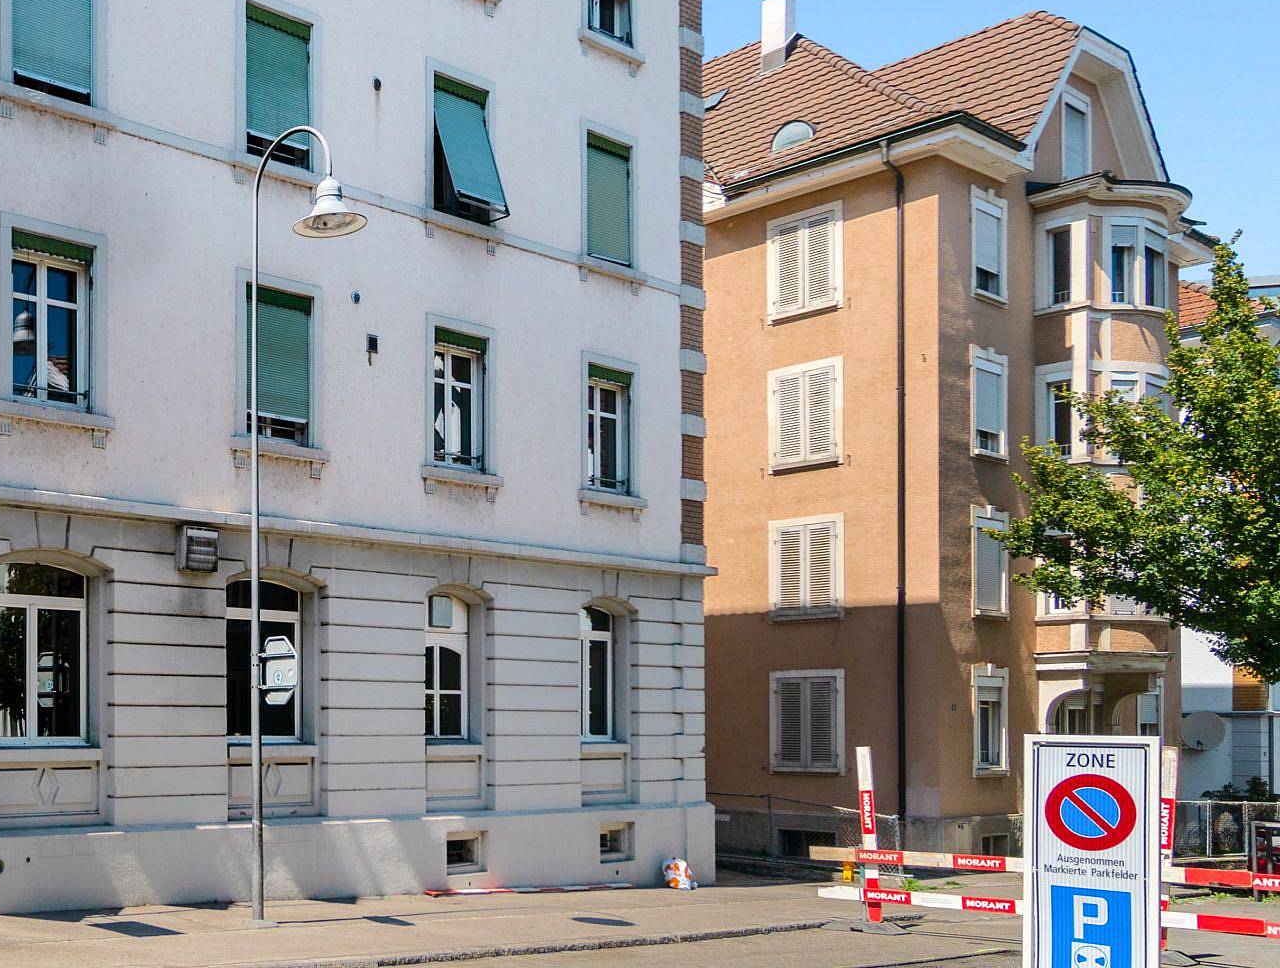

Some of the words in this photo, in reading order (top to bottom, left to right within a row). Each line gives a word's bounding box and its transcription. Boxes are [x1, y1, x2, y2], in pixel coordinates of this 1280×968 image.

[1066, 752, 1116, 769] ZONE
[862, 793, 872, 830] MORANT
[1161, 802, 1170, 845] MORANT
[858, 852, 898, 861] MORANT
[957, 858, 1001, 867] MORANT
[1056, 853, 1125, 867] Ausgenommen
[1043, 864, 1087, 876] Markierte
[1091, 867, 1138, 880] Parkfelder
[1253, 877, 1280, 887] ANT
[867, 892, 907, 902] MORANT
[966, 900, 1010, 910] MORANT
[1073, 894, 1109, 940] P
